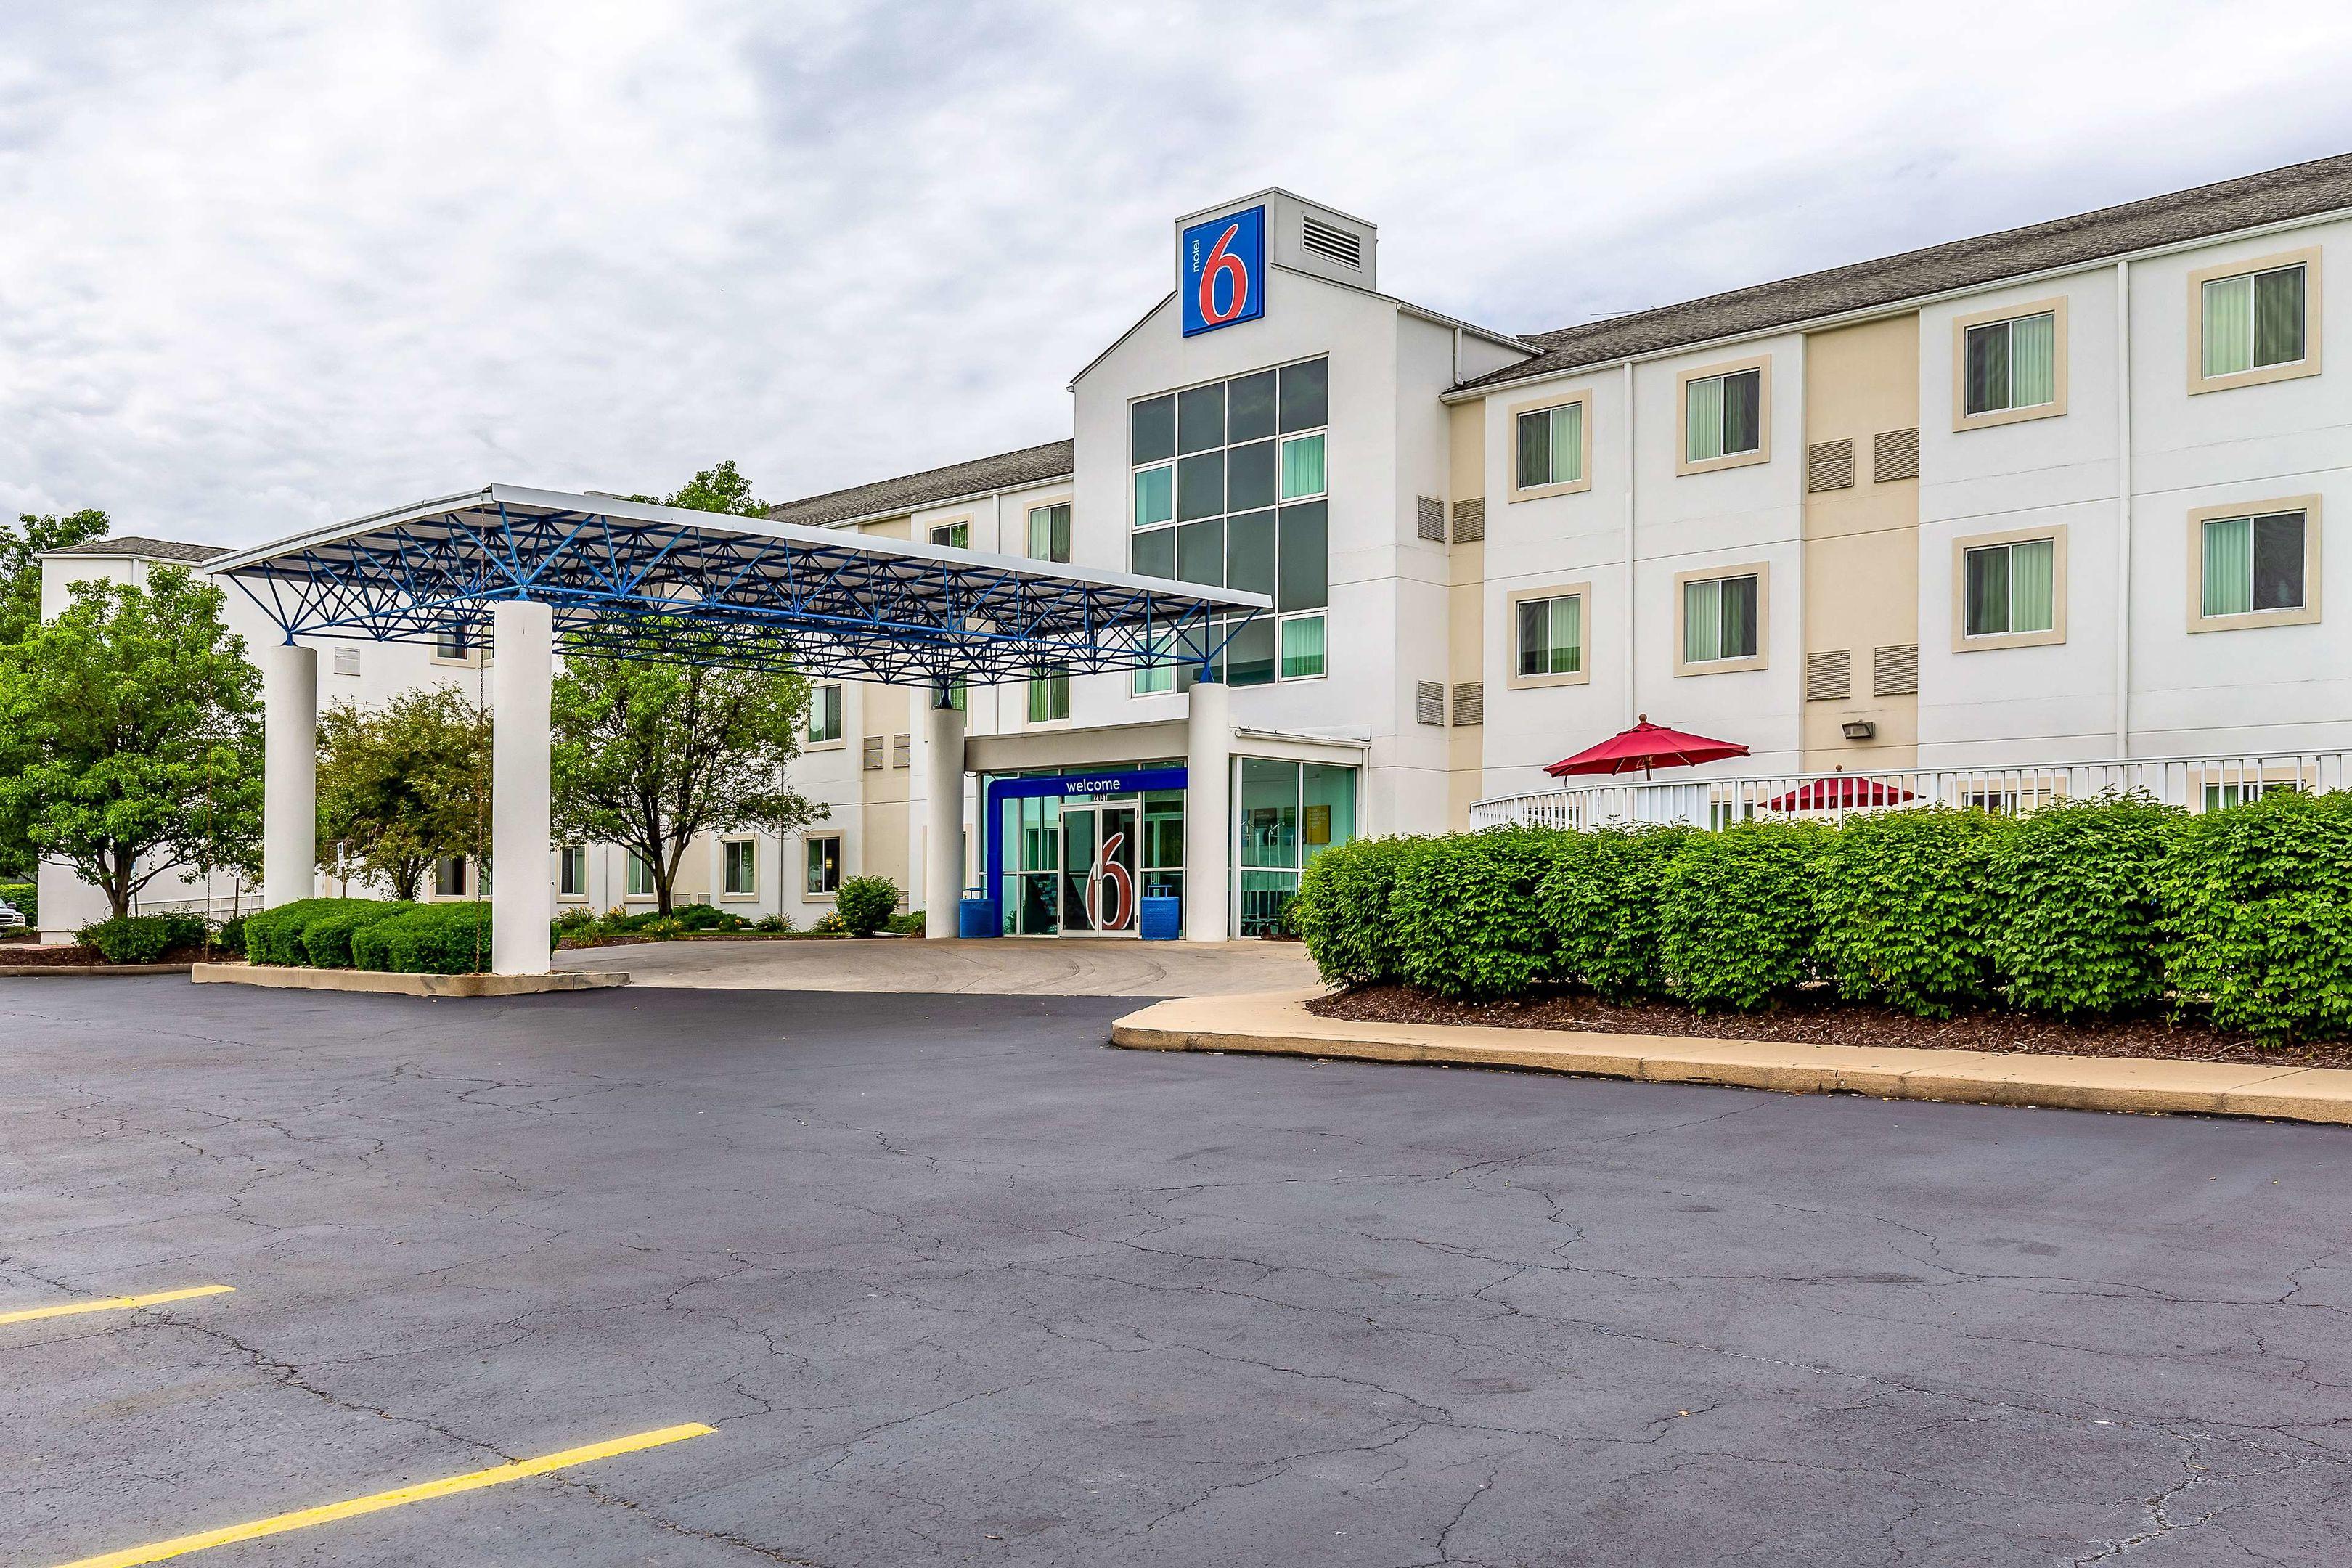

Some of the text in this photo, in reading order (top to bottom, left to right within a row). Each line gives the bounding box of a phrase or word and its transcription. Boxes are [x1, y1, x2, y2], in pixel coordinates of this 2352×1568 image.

[1199, 224, 1248, 324] 6
[1066, 779, 1120, 793] welcome
[1085, 832, 1133, 930] 6
